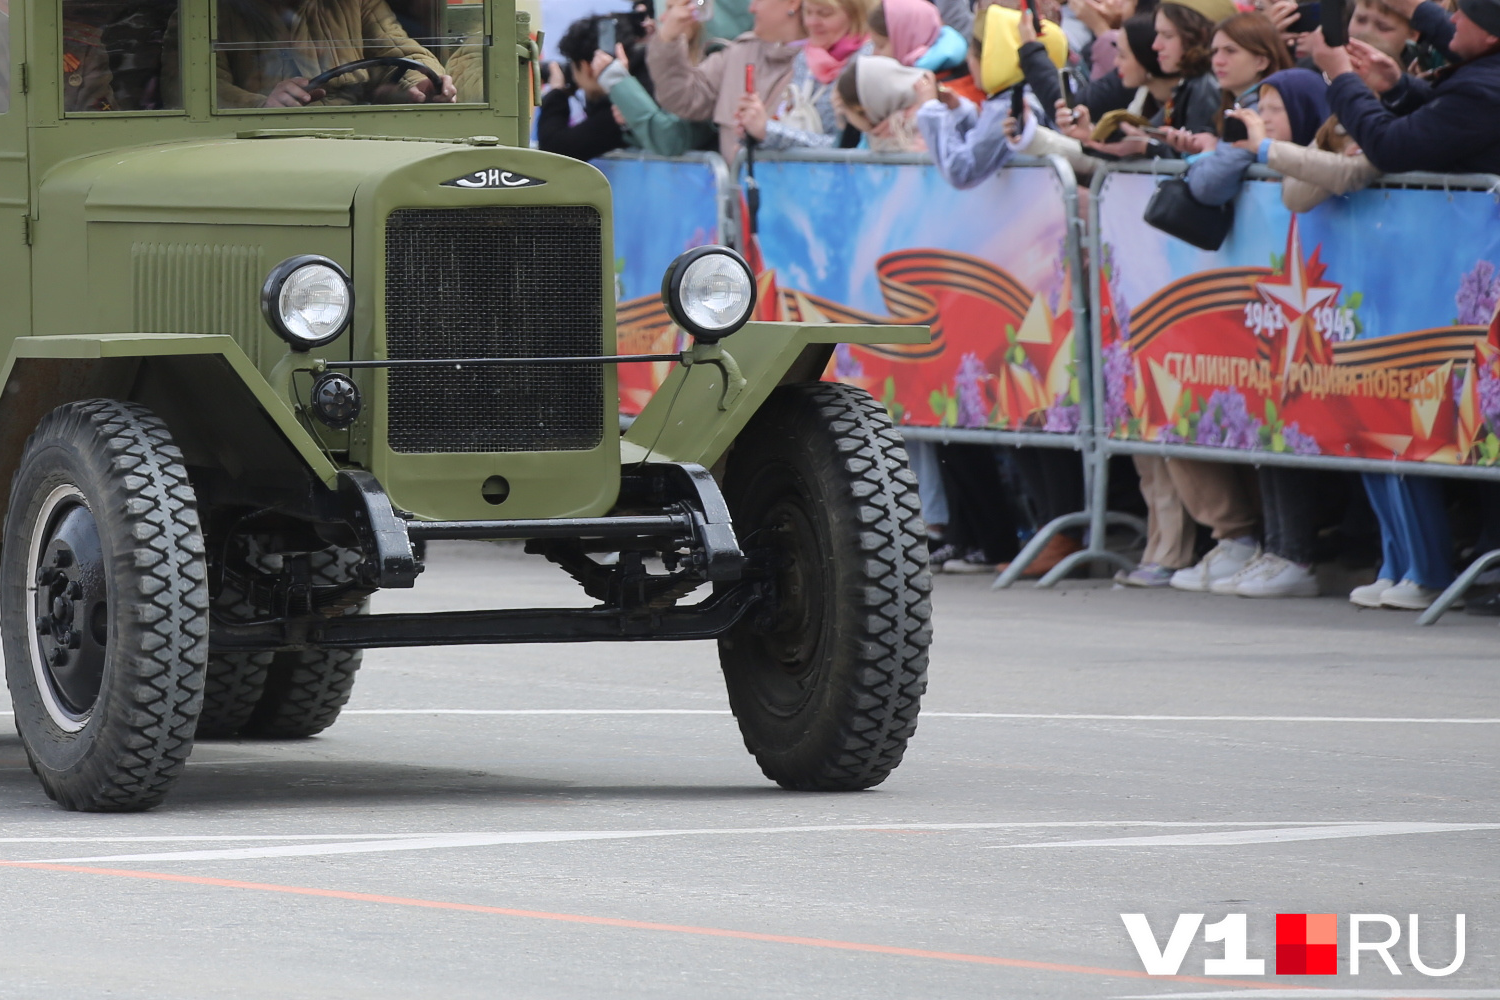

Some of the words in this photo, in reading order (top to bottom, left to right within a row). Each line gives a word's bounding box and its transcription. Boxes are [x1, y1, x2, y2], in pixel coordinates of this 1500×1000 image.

[1244, 301, 1284, 338] 1941
[1313, 306, 1356, 342] 1945
[1163, 351, 1273, 397] СТАЛИНГРАД
[1288, 361, 1359, 400] РОДИНА
